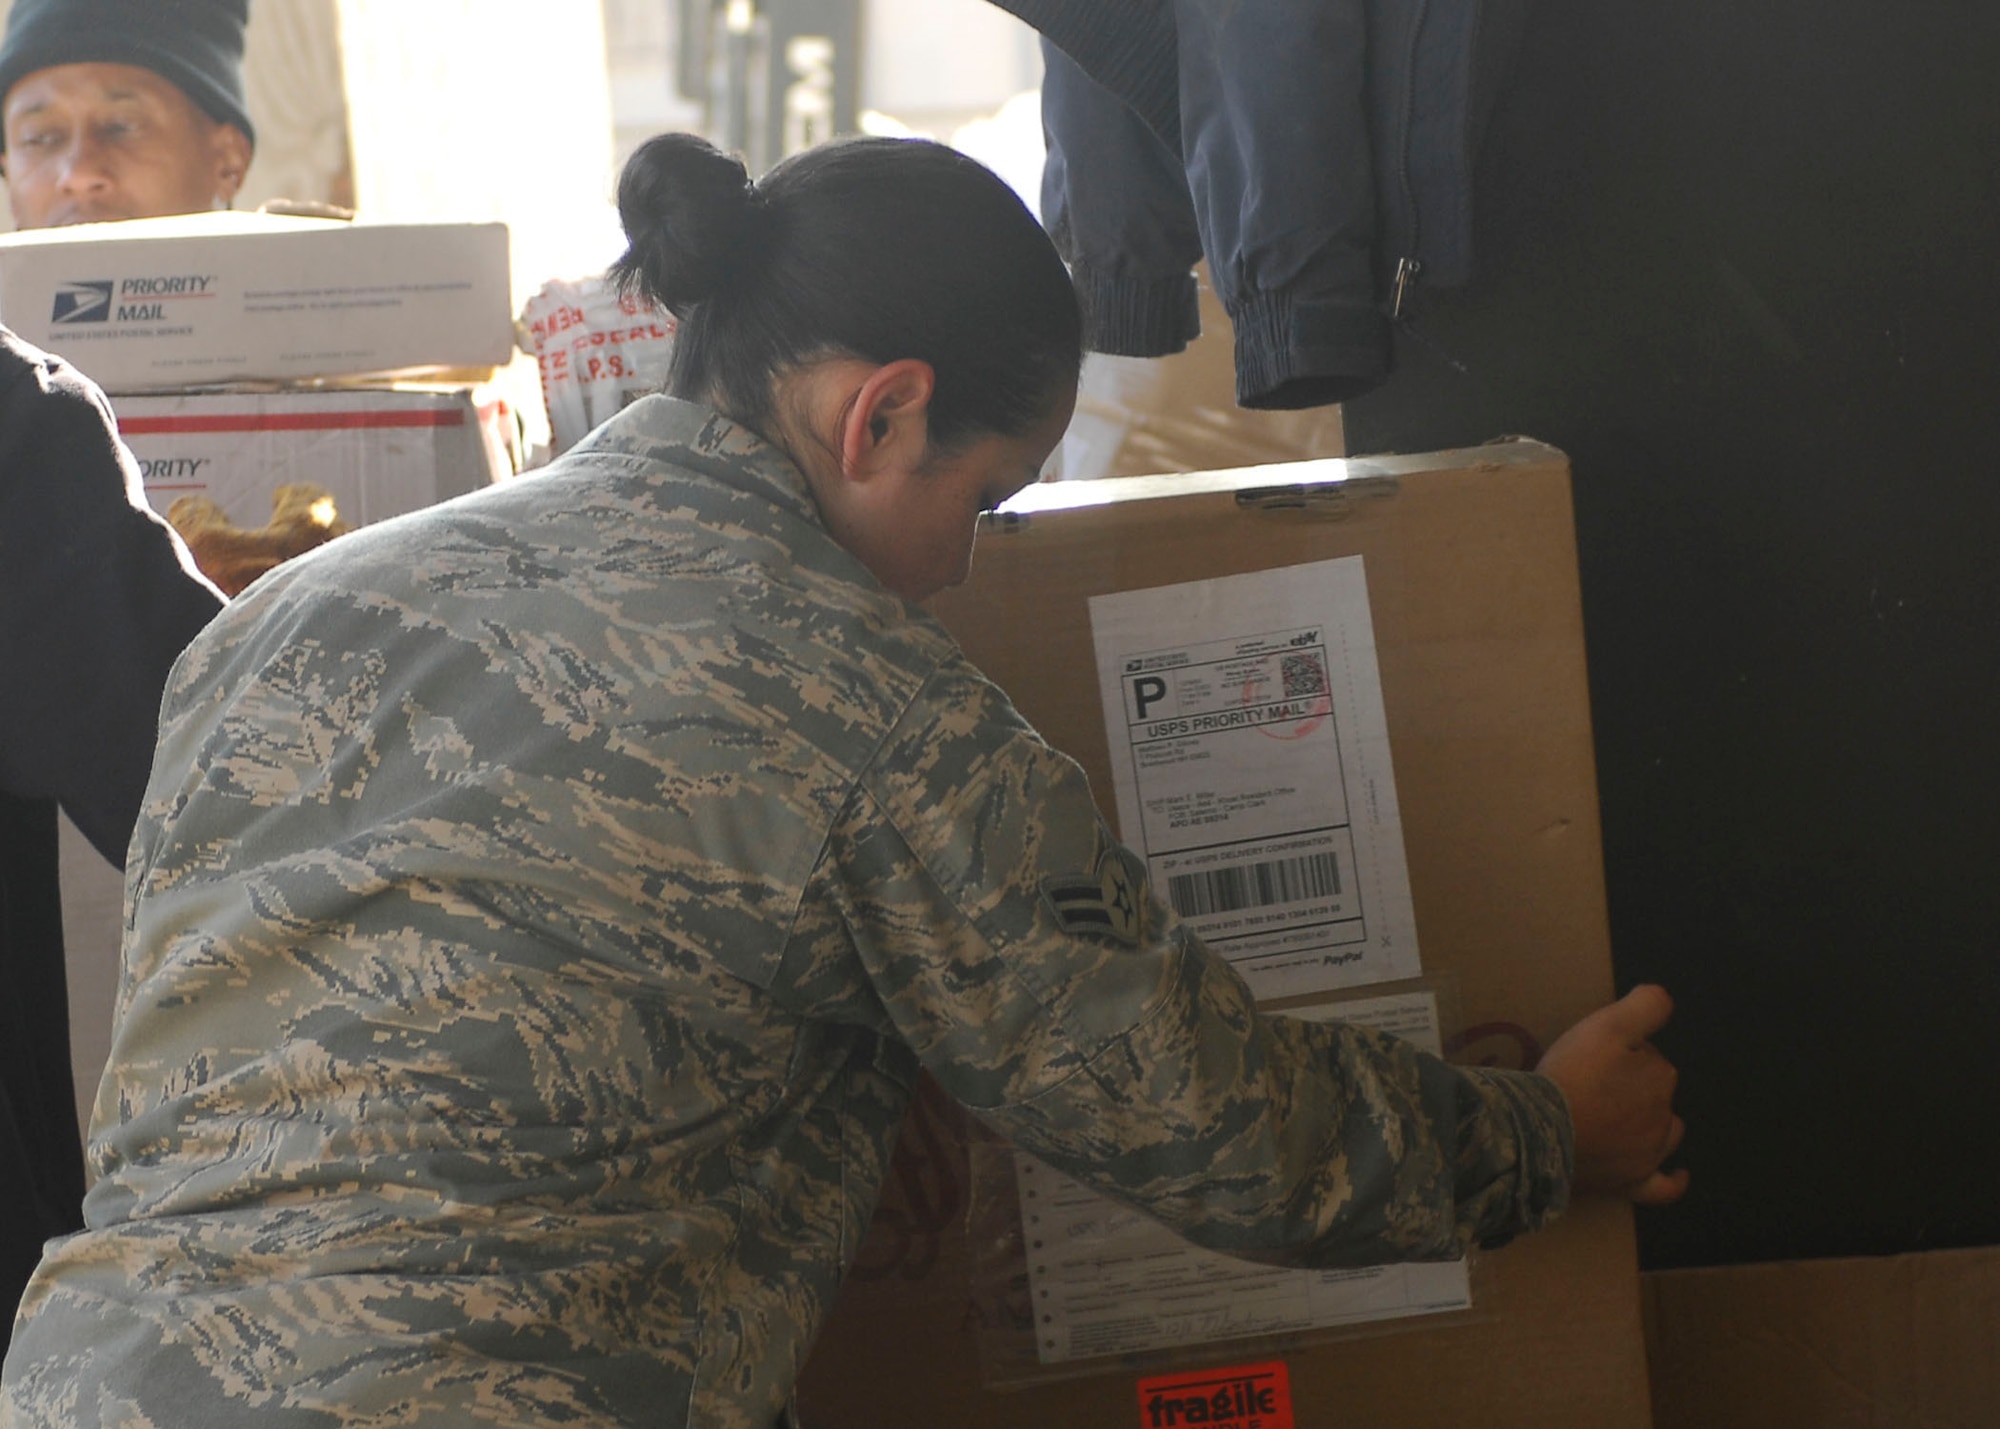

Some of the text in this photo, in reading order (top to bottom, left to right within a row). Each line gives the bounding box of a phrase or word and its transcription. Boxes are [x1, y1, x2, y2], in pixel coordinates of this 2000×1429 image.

[121, 275, 212, 294] PRIORITY
[116, 304, 167, 321] MAIL
[138, 458, 202, 477] ORITY
[1133, 676, 1166, 719] P
[1147, 720, 1189, 738] USPS
[1193, 709, 1263, 731] PRIORITY
[1169, 818, 1188, 829] APO
[1220, 848, 1263, 861] DELIVERY
[1266, 836, 1334, 853] CONFIRMATION
[1323, 951, 1363, 967] PayPal
[1147, 1380, 1277, 1427] fragile
